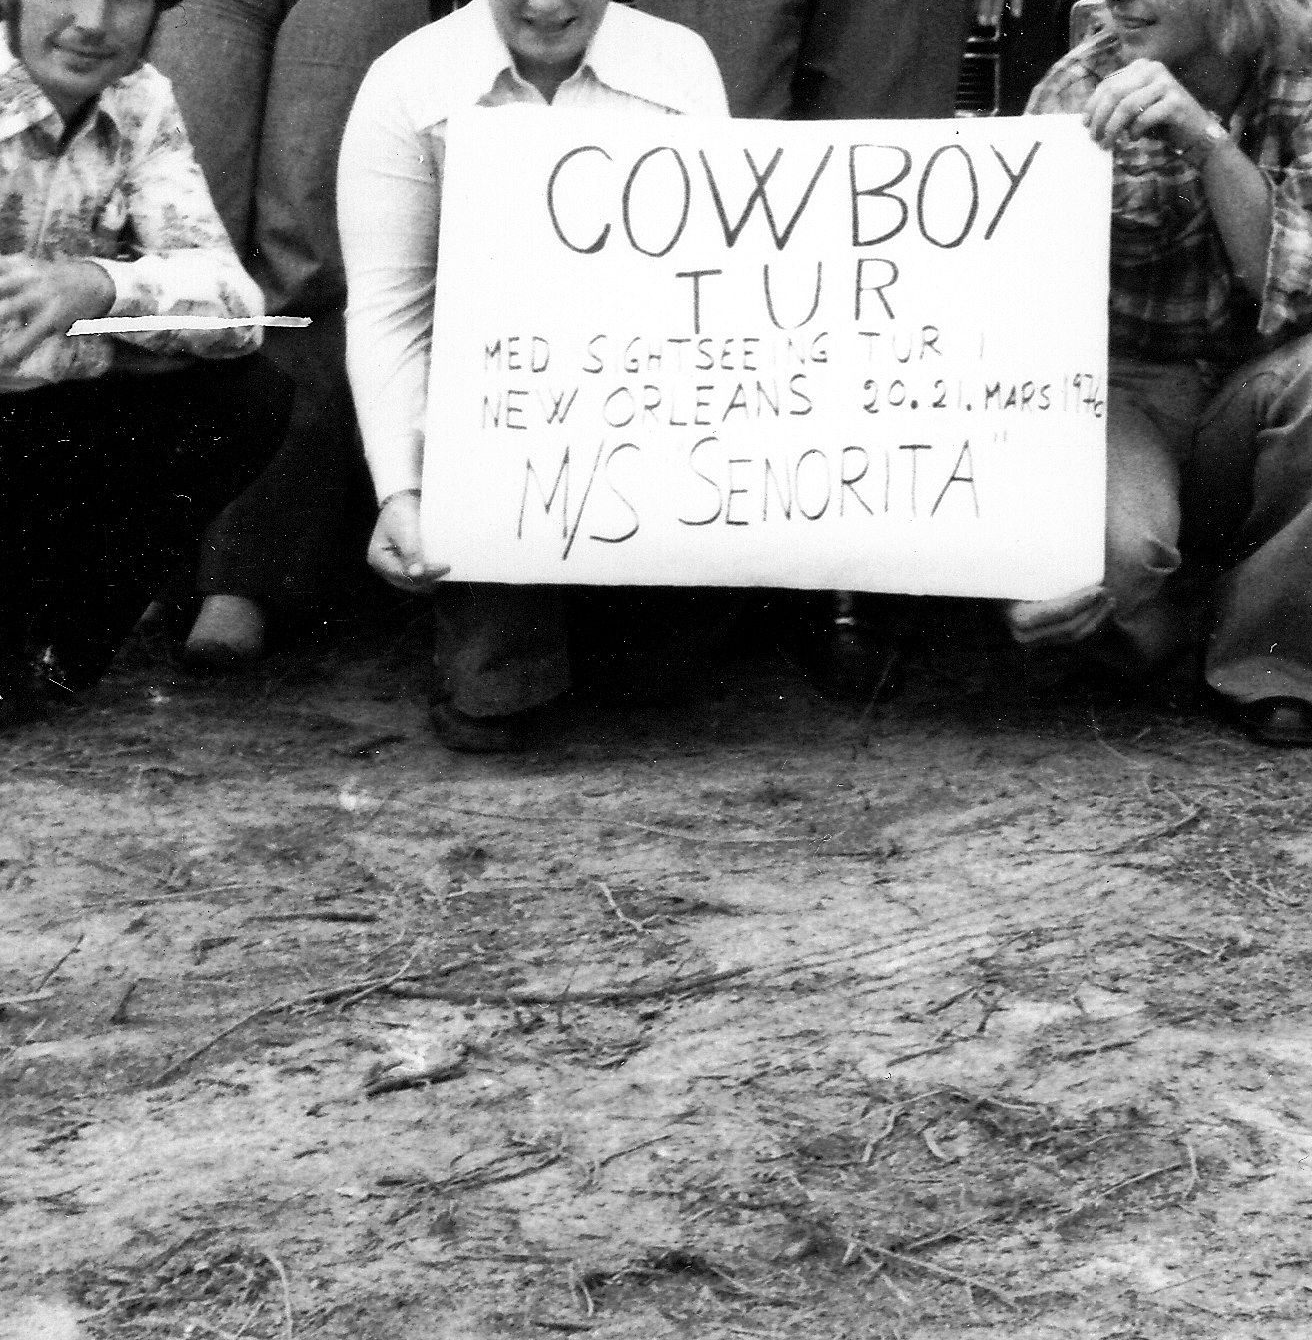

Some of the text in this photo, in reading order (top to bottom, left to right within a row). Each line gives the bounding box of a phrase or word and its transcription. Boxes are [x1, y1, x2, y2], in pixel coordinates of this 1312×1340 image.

[546, 141, 1042, 258] COWBOY
[676, 257, 900, 335] TUR
[484, 335, 551, 374] MED
[582, 331, 829, 374] SIGHTSEEING
[857, 324, 943, 364] TUR
[481, 385, 579, 430] NEW
[602, 373, 814, 429] ORLEANS
[984, 380, 1052, 411] MARS
[517, 437, 640, 561] M/S
